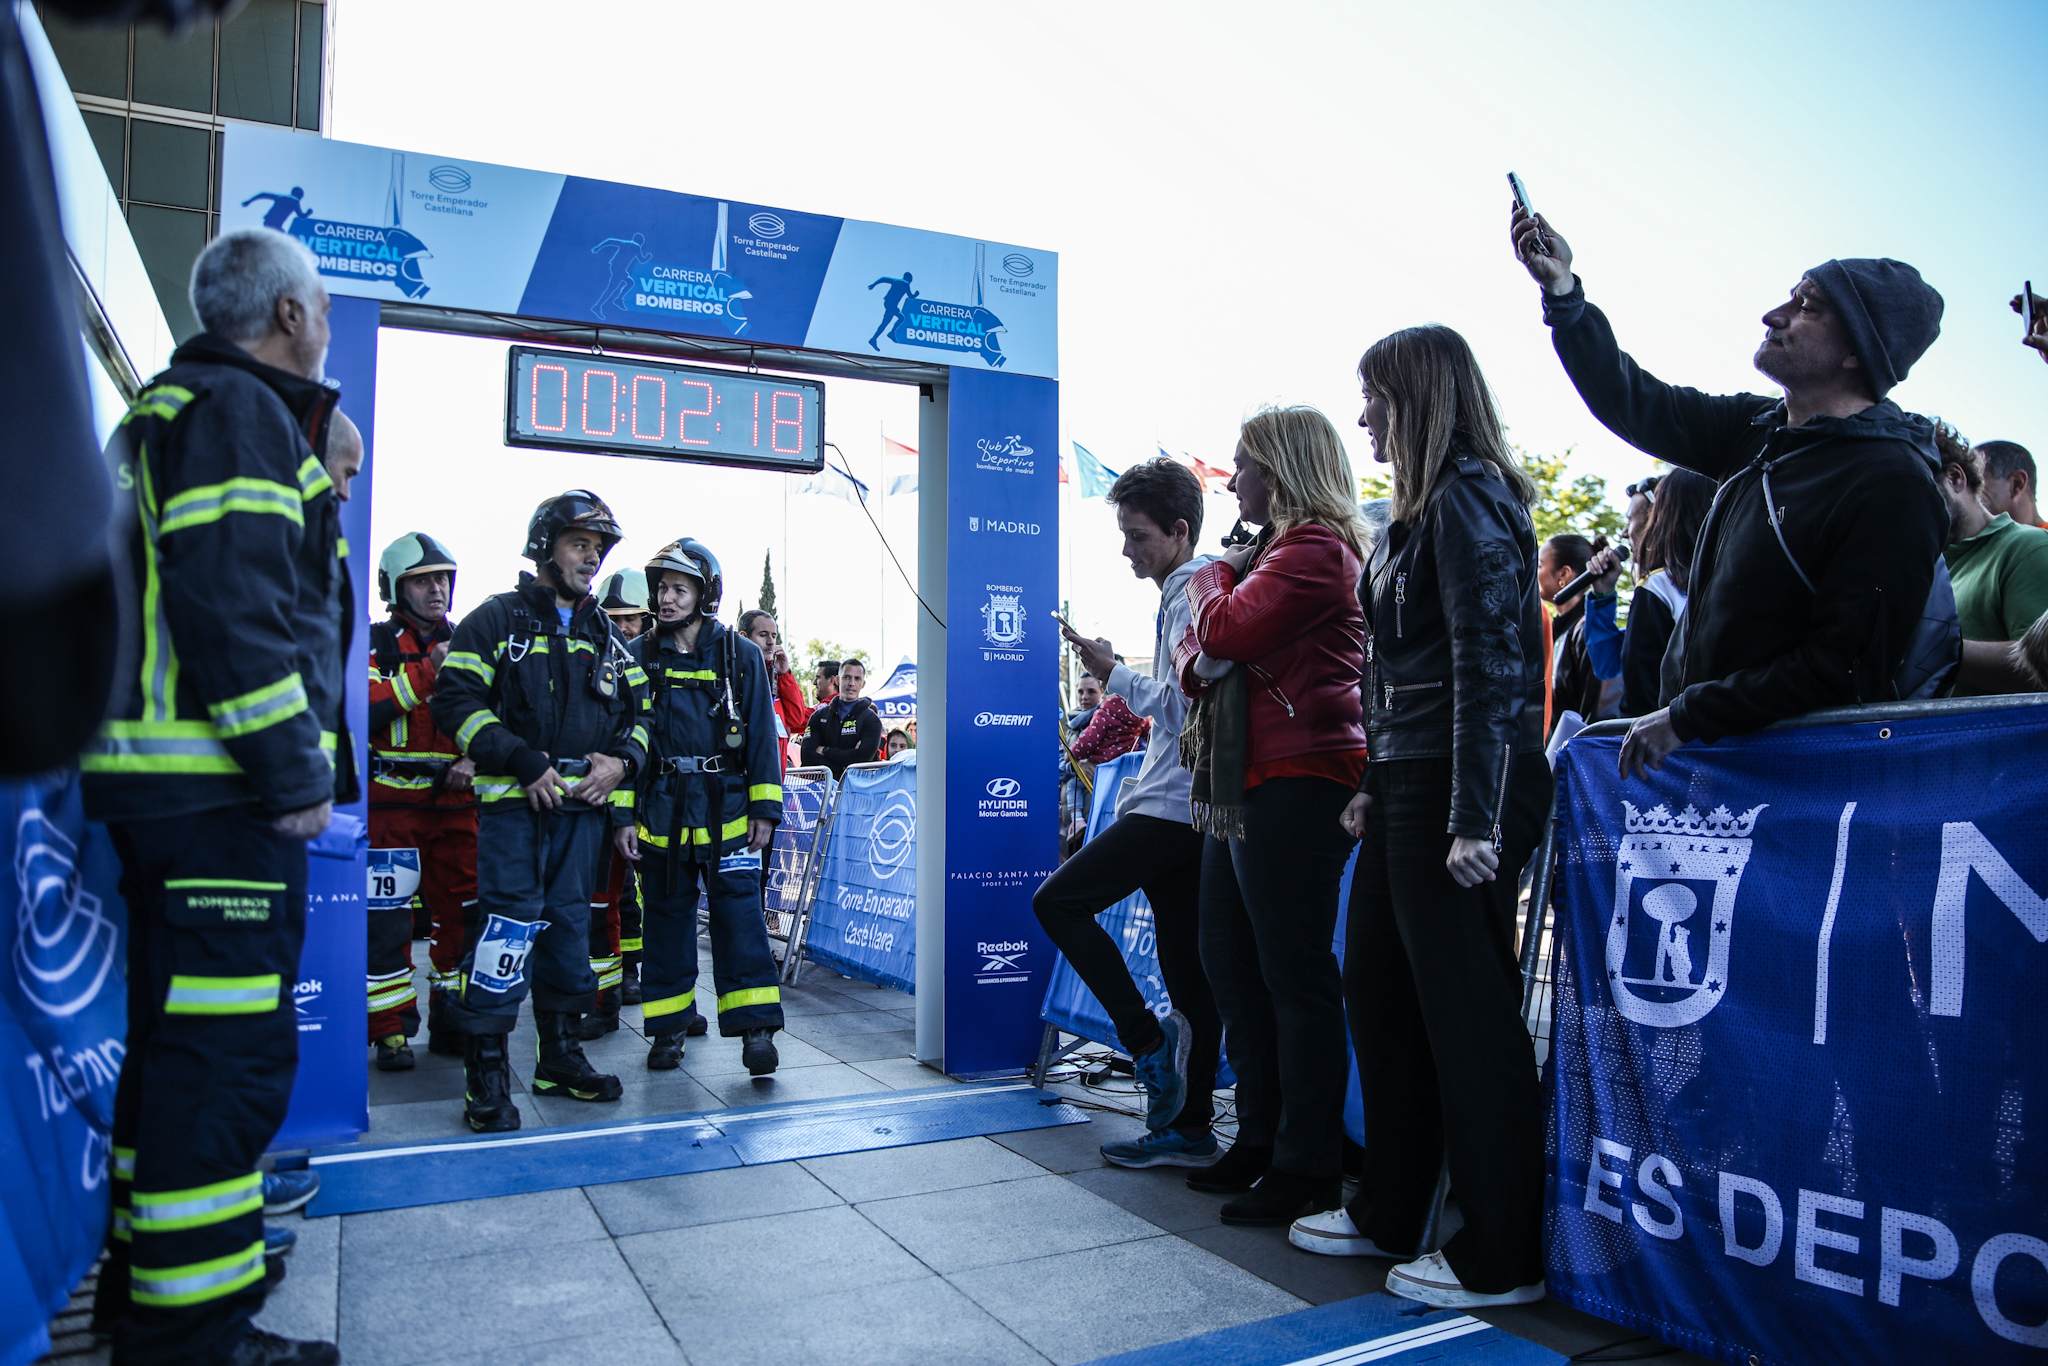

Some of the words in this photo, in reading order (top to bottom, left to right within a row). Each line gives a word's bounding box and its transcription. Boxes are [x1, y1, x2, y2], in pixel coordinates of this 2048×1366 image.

[410, 190, 435, 201] Torre
[437, 194, 489, 209] Emperador
[424, 203, 474, 217] Castellana
[314, 223, 386, 243] CARRERA
[299, 235, 404, 263] VERTICAL
[733, 235, 754, 246] Torre
[756, 239, 800, 253] Emperador
[745, 247, 788, 260] Castellana
[313, 255, 398, 277] OMBEROS
[653, 266, 713, 285] CARRERA
[989, 274, 1008, 285] Torre
[1009, 278, 1047, 291] Emperador
[640, 278, 728, 302] VERTICAL
[999, 285, 1036, 297] Castellana
[635, 293, 724, 316] BOMBEROS
[920, 302, 973, 320] CARRERA
[909, 313, 986, 337] VERTICAL
[906, 328, 983, 349] BOMBEROS
[531, 364, 803, 454] 00:02:18
[976, 438, 1002, 451] Club
[981, 448, 1034, 467] Deportivo
[976, 462, 1003, 472] bomberos
[987, 519, 1041, 535] MADRID
[986, 584, 1023, 593] BOMBEROS
[993, 652, 1025, 662] MADRID
[992, 713, 1033, 726] ENERVIT
[979, 800, 1028, 810] HYUNDAI
[979, 810, 999, 818] Motor
[1000, 810, 1028, 818] Gamboa
[951, 872, 993, 880] PALACIO
[998, 871, 1029, 879] SANTA
[373, 876, 396, 896] 79
[187, 896, 271, 909] BOMBEROS
[331, 893, 359, 902] ANA
[837, 885, 864, 911] Torre
[977, 940, 1029, 954] Reebok
[496, 952, 525, 978] 94
[1583, 1135, 1683, 1240] ES
